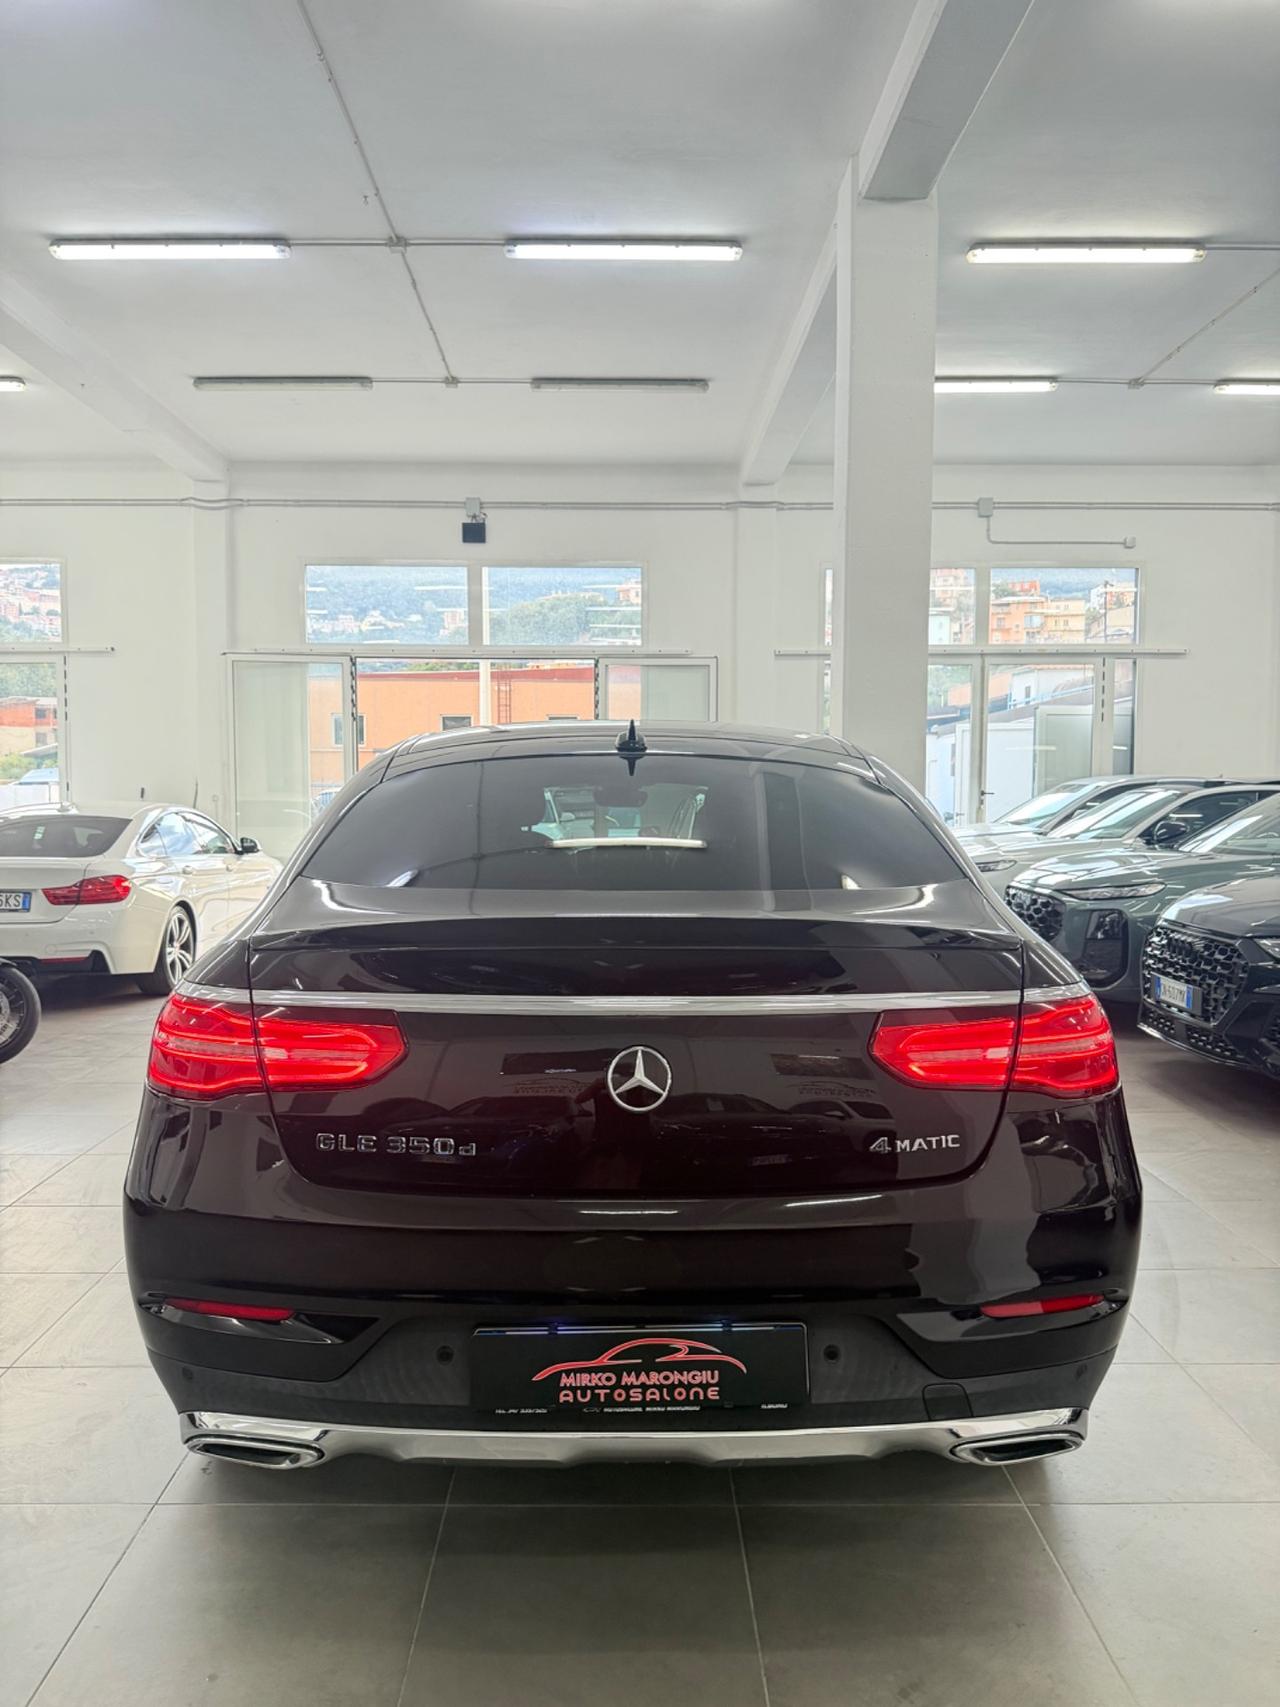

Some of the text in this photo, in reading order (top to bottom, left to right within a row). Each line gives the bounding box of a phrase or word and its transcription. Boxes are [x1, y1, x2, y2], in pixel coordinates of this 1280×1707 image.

[316, 1133, 377, 1152] GLE
[560, 1370, 719, 1387] MIRKO MARONGIU
[559, 1387, 720, 1403] AUTOSALONE
